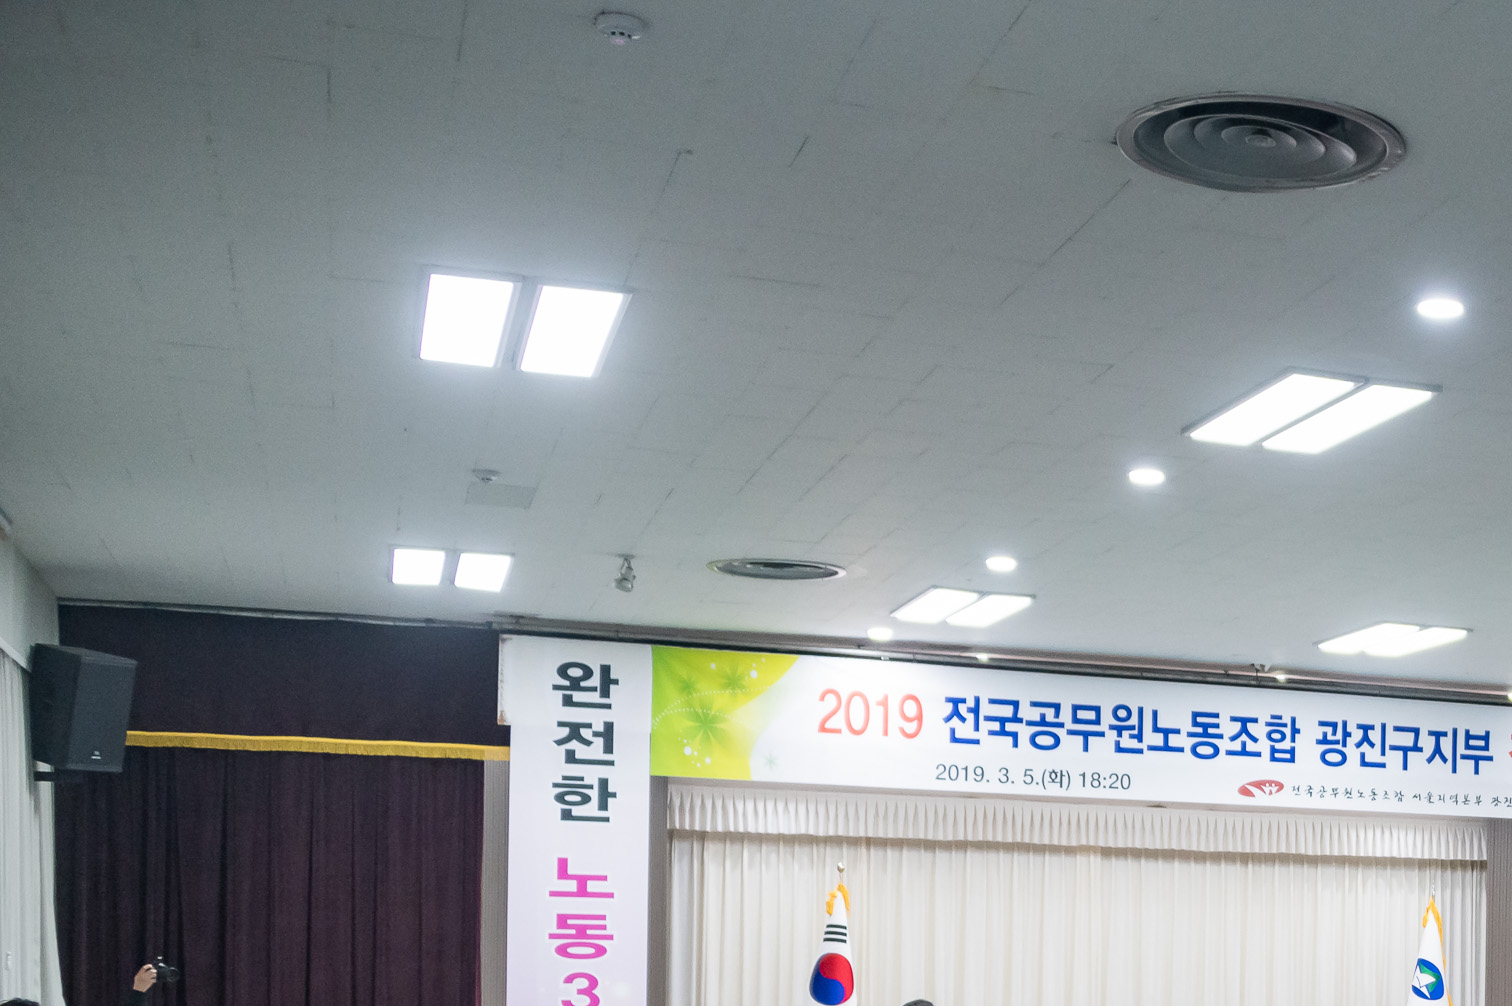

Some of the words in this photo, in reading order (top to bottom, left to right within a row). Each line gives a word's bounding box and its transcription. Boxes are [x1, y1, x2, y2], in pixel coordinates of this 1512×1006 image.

[551, 660, 620, 823] 완전한
[817, 687, 924, 740] 2019
[943, 695, 1301, 764] 전국공무원노동조합
[1315, 719, 1494, 776] 광진구지부
[935, 763, 990, 783] 2019.
[997, 766, 1015, 785] 3.
[1023, 768, 1071, 791] 5.(화)
[1078, 771, 1132, 790] 18:20
[1291, 785, 1405, 803] 전국공무원노동조합
[1412, 791, 1482, 806] 서울지역본부
